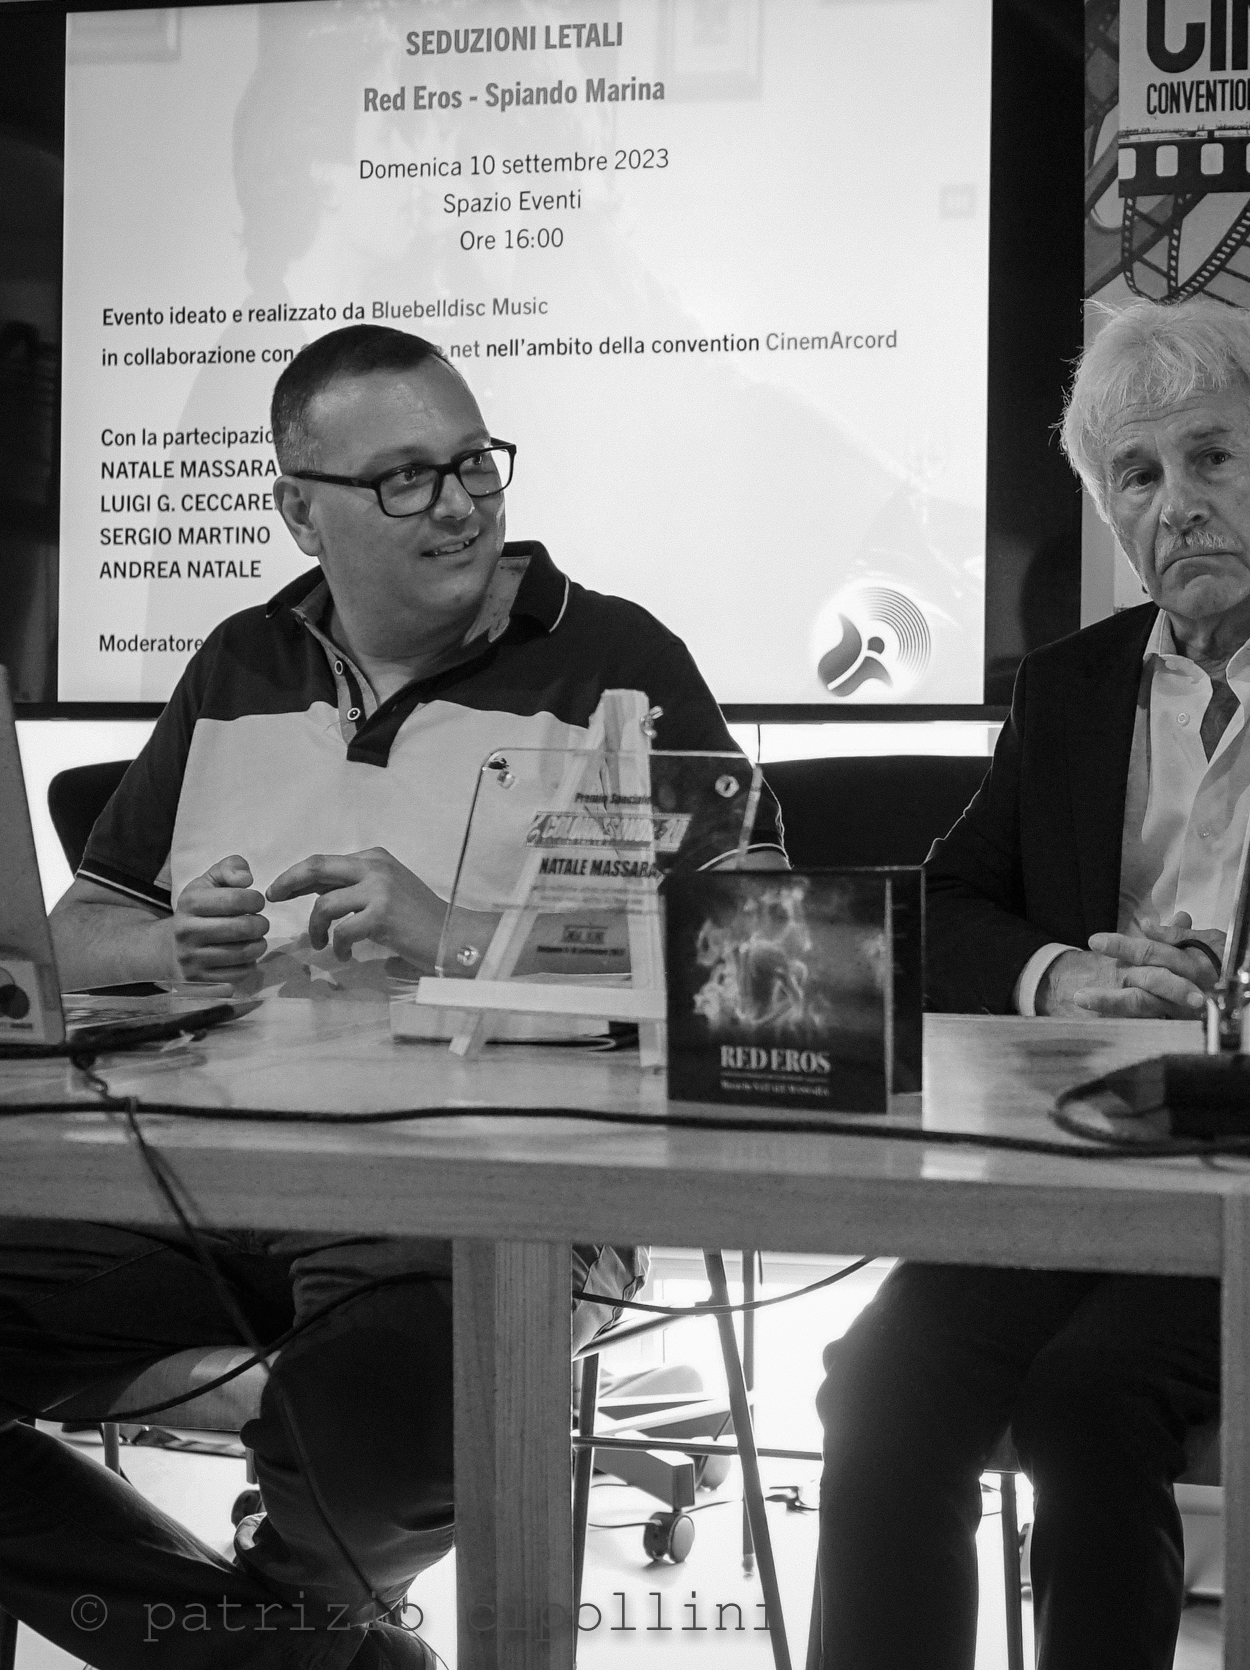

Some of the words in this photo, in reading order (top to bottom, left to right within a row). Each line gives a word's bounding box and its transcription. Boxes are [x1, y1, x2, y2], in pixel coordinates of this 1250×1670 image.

[405, 25, 537, 57] SEDUZIONI
[544, 21, 623, 51] LETALI
[363, 85, 406, 113] Red
[413, 85, 463, 111] Eros
[485, 80, 577, 112] Spiando
[585, 75, 666, 104] Marina
[359, 156, 462, 180] Domenica
[470, 154, 496, 176] 10
[502, 151, 608, 175] settembre
[614, 147, 669, 170] 2023
[443, 191, 512, 218] Spazio
[519, 188, 581, 211] Eventi
[459, 230, 496, 251] Ore
[505, 227, 564, 250] 16:00
[102, 307, 164, 327] Evento
[169, 305, 227, 325] ideato
[232, 309, 243, 324] e
[248, 303, 337, 323] realizzato
[343, 302, 365, 321] da
[371, 298, 486, 320] Bluebelldisc
[492, 296, 549, 316] Music
[102, 348, 118, 367] in
[123, 345, 256, 367] collaborazione
[261, 348, 294, 363] con
[598, 335, 645, 355] della
[651, 333, 760, 354] convention
[765, 329, 898, 352] CinemArcord
[100, 428, 136, 447] Con
[141, 427, 157, 446] la
[101, 460, 175, 480] NATALE
[181, 458, 278, 478] MASSARA
[100, 494, 151, 513] LUIGI
[157, 493, 176, 513] G.
[180, 492, 277, 513] CECCARE
[99, 526, 172, 546] SERGIO
[178, 525, 271, 545] MARTINO
[99, 560, 182, 579] ANDREA
[187, 560, 262, 579] NATALE
[539, 858, 588, 876] NATALE
[589, 859, 658, 879] MASSARA
[720, 1045, 768, 1070] RED
[770, 1048, 832, 1074] EROS
